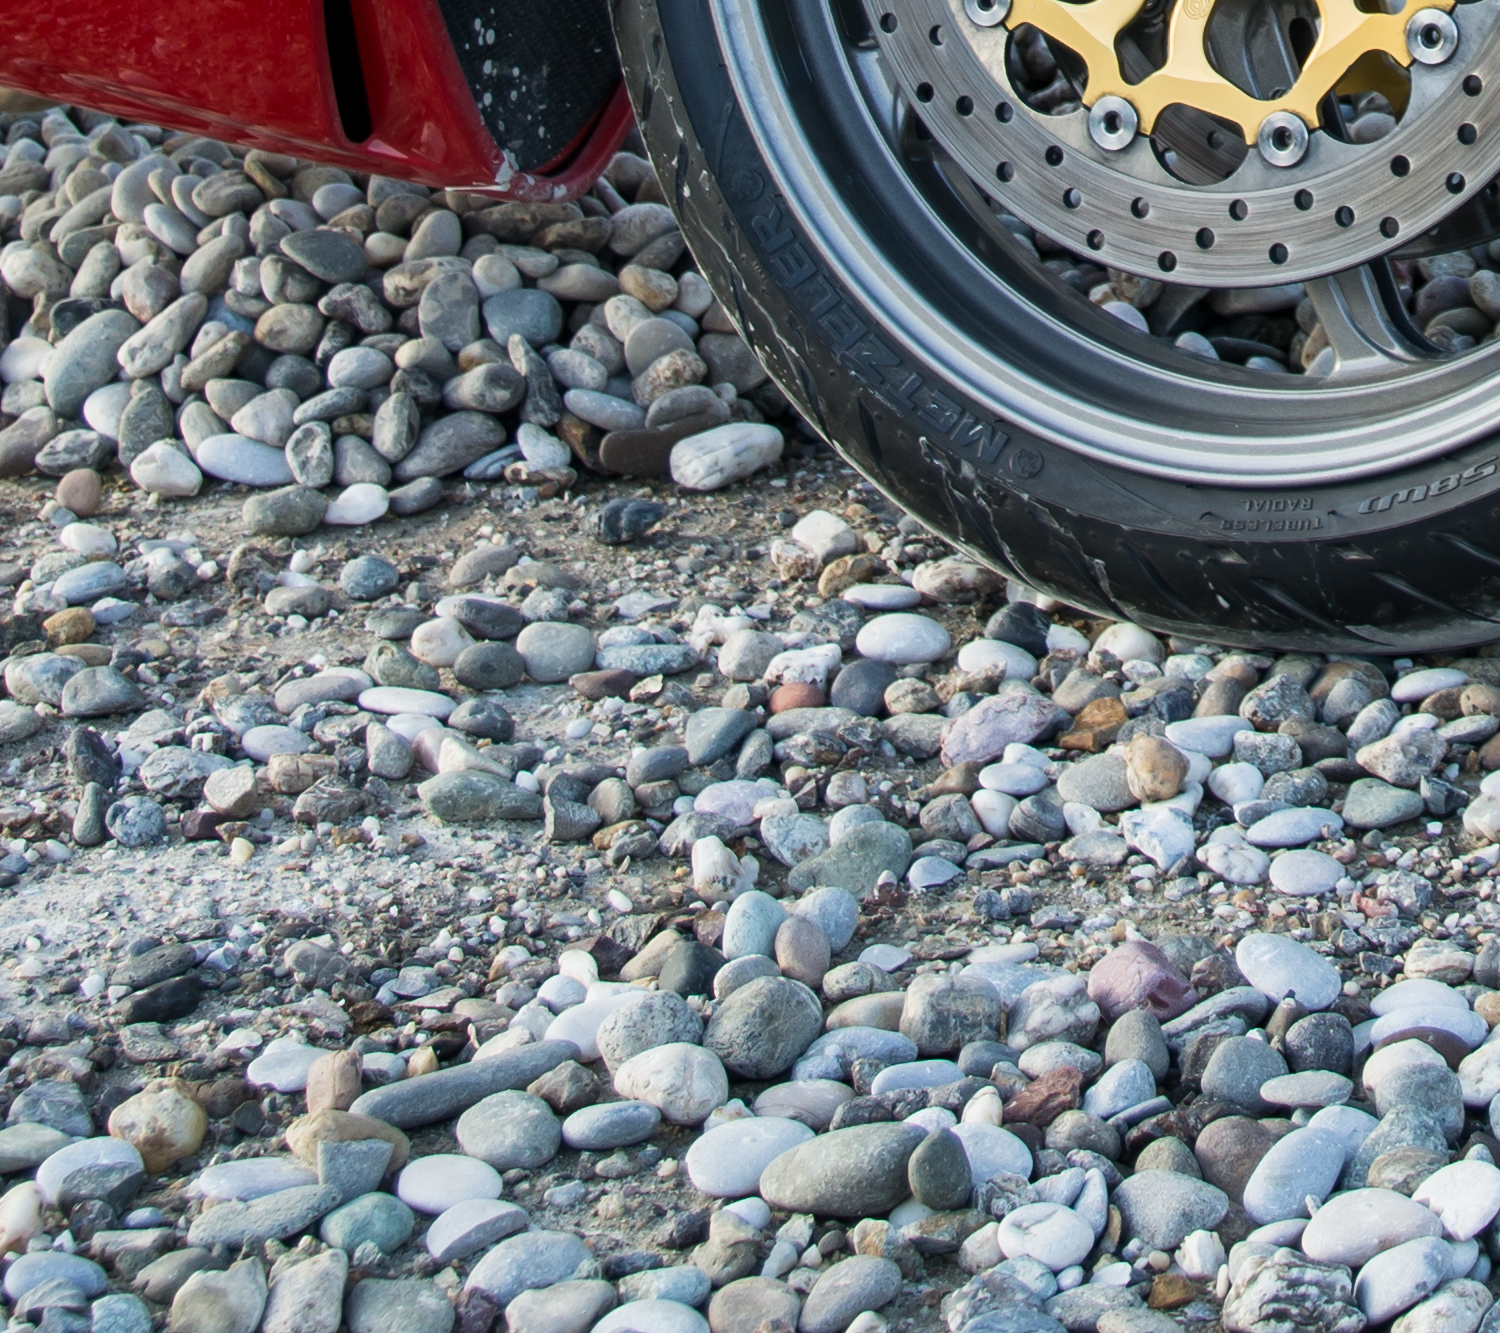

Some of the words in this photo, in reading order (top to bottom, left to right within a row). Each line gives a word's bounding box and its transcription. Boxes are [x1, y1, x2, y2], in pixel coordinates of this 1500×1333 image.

[751, 202, 1010, 464] METZELER
[1240, 496, 1315, 513] RADIAL
[1218, 514, 1326, 532] TUBELESS
